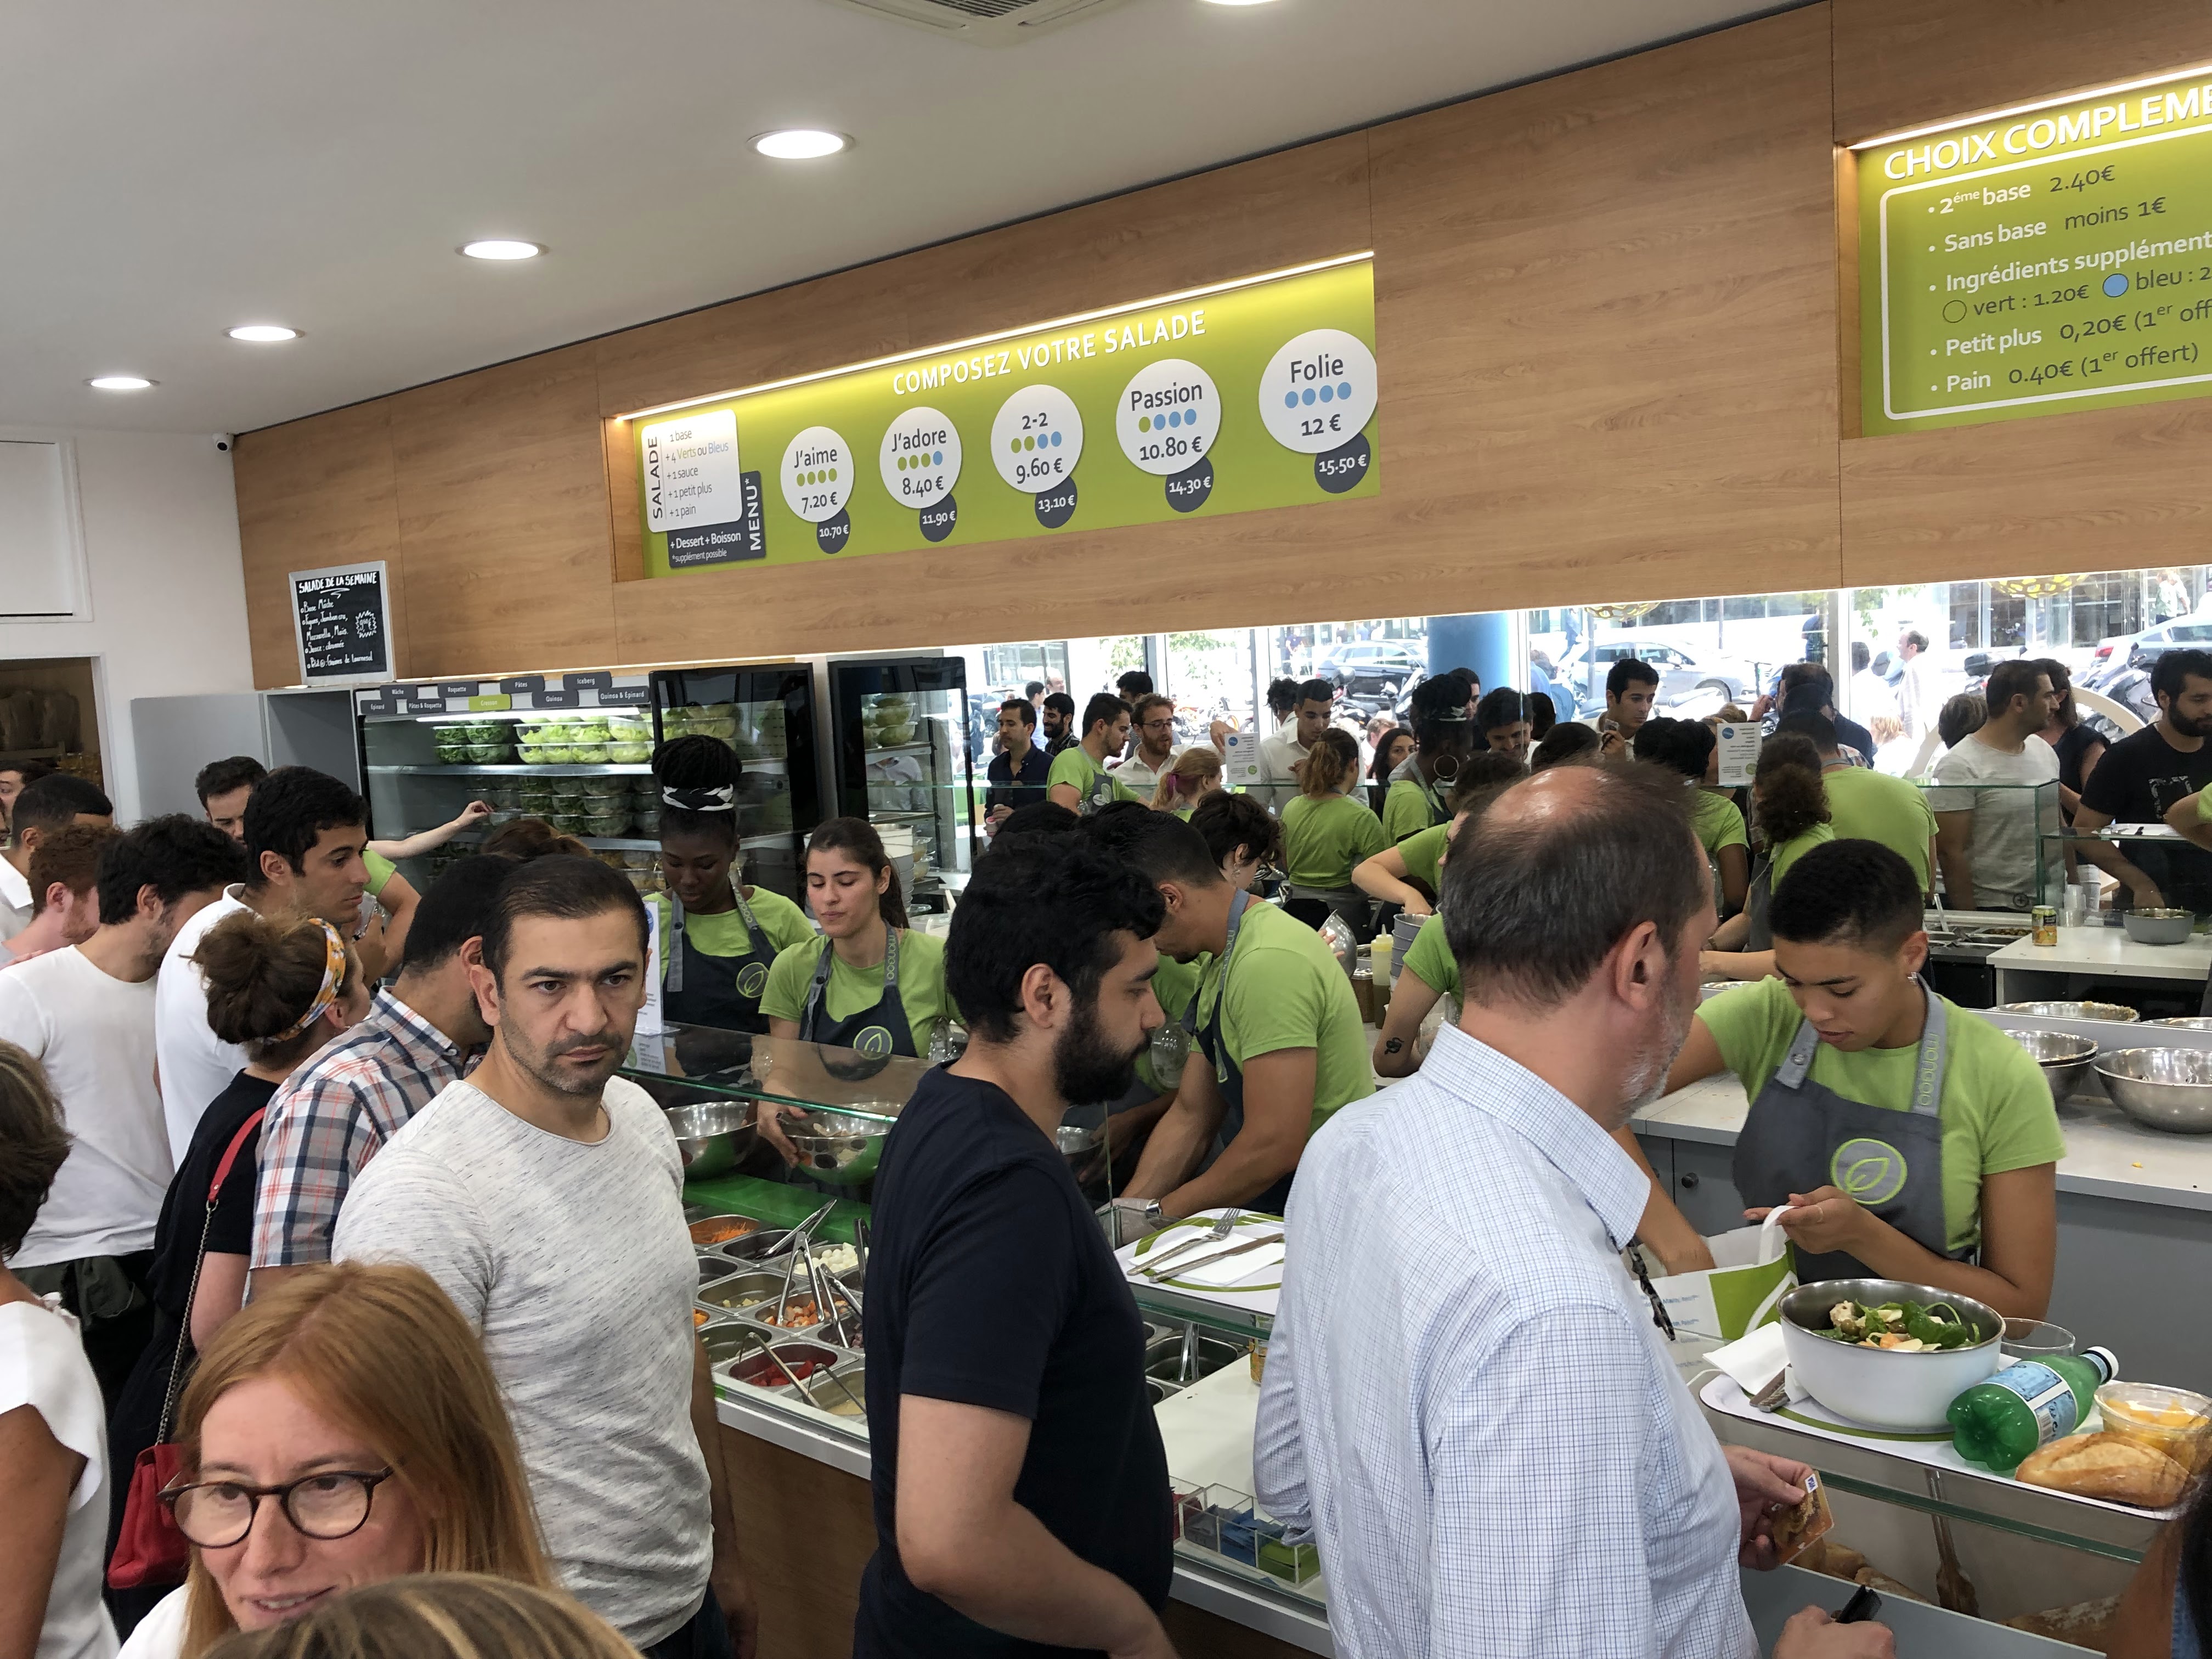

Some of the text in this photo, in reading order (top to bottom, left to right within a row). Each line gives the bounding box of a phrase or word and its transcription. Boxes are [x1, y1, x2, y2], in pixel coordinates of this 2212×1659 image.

[1884, 130, 1997, 179] CHOIX
[1983, 184, 2031, 205] base
[2050, 165, 2115, 192] 2.40€
[1945, 196, 2166, 252] Sans base moins 1€
[1946, 257, 2069, 294] Ingrédients
[1973, 295, 2015, 315] vert
[2034, 285, 2089, 306] 1.20€
[2136, 269, 2182, 290] bleu
[1946, 333, 1996, 356] Petit
[2000, 328, 2042, 354] plus
[2060, 315, 2126, 342] 0,20€
[893, 309, 1207, 395] COMPOSEZ VOTRE SALADE
[1291, 353, 1344, 383] Folie
[1947, 371, 1991, 392] Pain
[2008, 360, 2073, 385] 0.40€
[2125, 342, 2198, 368] offert)
[1131, 382, 1203, 411] Passion
[1022, 412, 1048, 430] 2-2
[1301, 419, 1324, 436] 12
[675, 430, 692, 441] base
[891, 428, 946, 452] J'adore
[676, 447, 696, 460] Verts
[697, 447, 707, 456] ou
[708, 441, 729, 454] Bleus
[794, 447, 838, 469] J'aime
[1139, 437, 1188, 461] 10.80
[678, 467, 698, 479] sauce
[1016, 458, 1049, 484] 9.60
[1318, 456, 1355, 476] 15.50
[647, 437, 663, 519] SALADE
[902, 477, 933, 498] 8.40
[1169, 478, 1201, 495] 14.30
[679, 484, 696, 500] petit
[697, 482, 712, 498] plus
[680, 504, 696, 519] pain
[802, 494, 827, 514] 7.20
[1037, 496, 1066, 513] 13.10
[922, 512, 947, 526] 11.90
[676, 535, 704, 549] Dessert
[711, 531, 741, 544] Boisson
[819, 526, 842, 539] 10.70
[706, 548, 727, 561] possible
[299, 572, 377, 594] SALADE DE LA SEMAINE
[624, 691, 645, 700] Épinard
